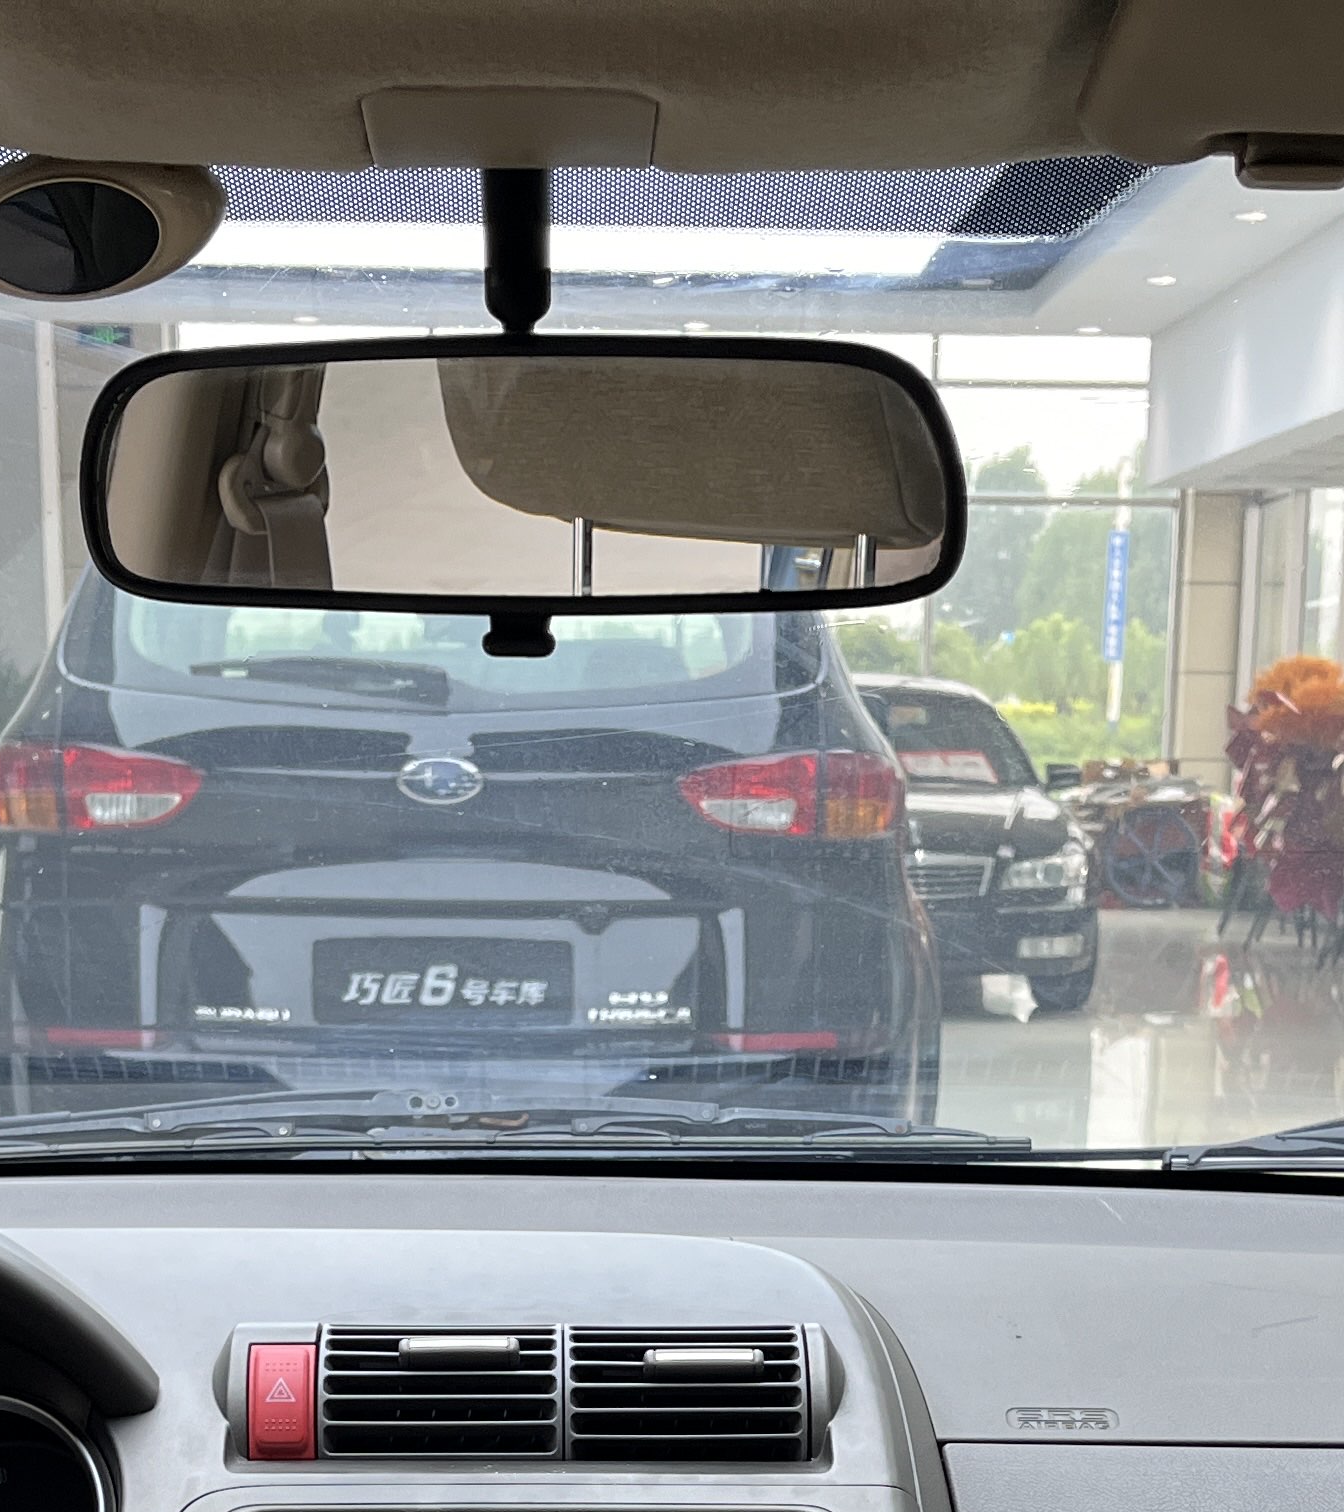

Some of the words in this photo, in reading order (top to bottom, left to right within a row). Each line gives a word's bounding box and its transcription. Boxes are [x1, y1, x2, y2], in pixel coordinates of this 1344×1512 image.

[341, 963, 550, 1007] 巧匠6号车库
